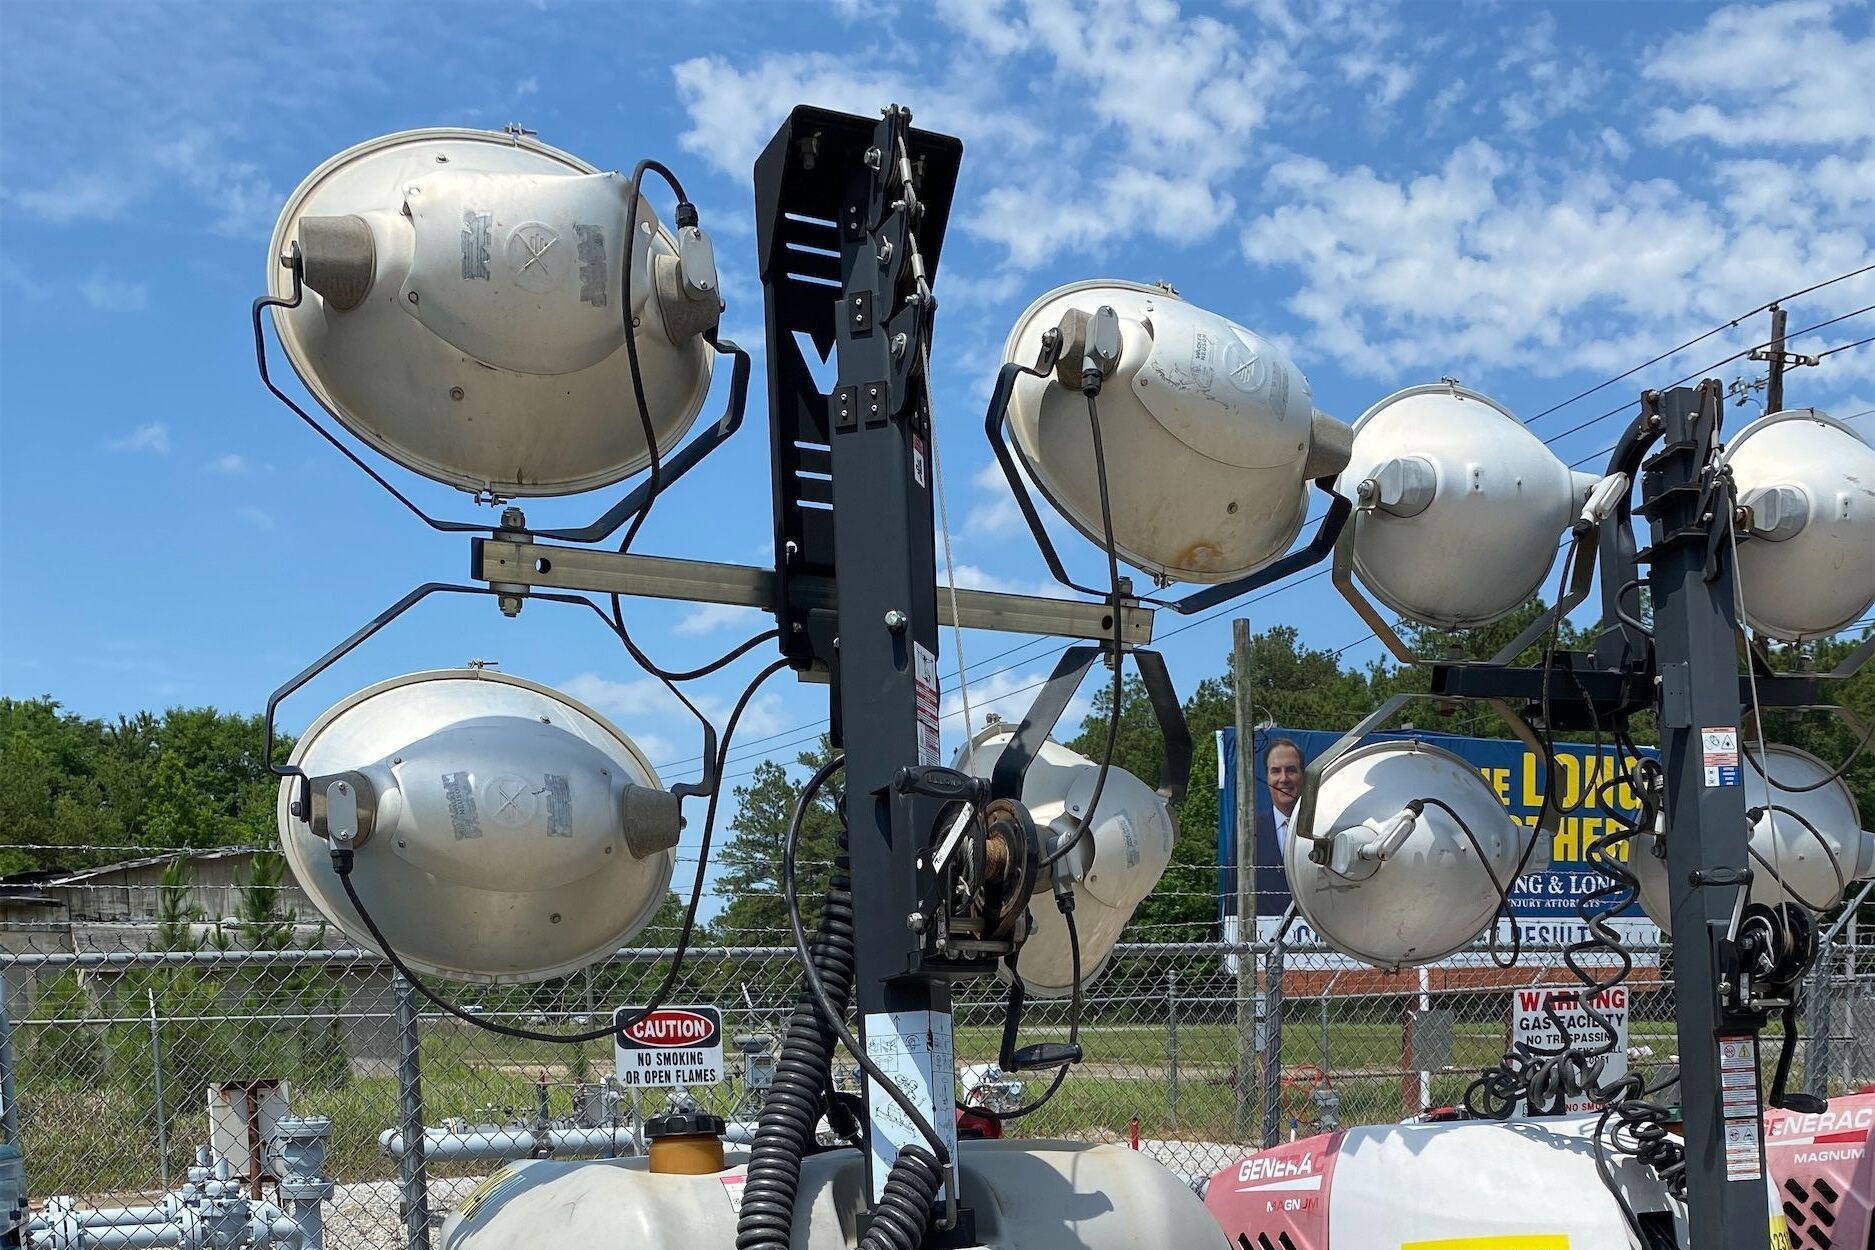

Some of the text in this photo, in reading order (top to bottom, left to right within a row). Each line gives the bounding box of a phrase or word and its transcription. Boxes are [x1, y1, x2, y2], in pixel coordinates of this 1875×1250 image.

[1514, 874, 1616, 894] NG & LON
[1508, 899, 1600, 907] NJURY ATTOREYS
[632, 1019, 706, 1038] CAUTION
[1520, 1013, 1625, 1031] GAS FACILTY
[1526, 1032, 1612, 1045] NO TRSPASSIN
[637, 1052, 704, 1066] NO SMOKING
[626, 1068, 716, 1084] OR OPEN FLAMES
[1565, 1103, 1579, 1112] NO
[1794, 1149, 1865, 1164] MAGNUM
